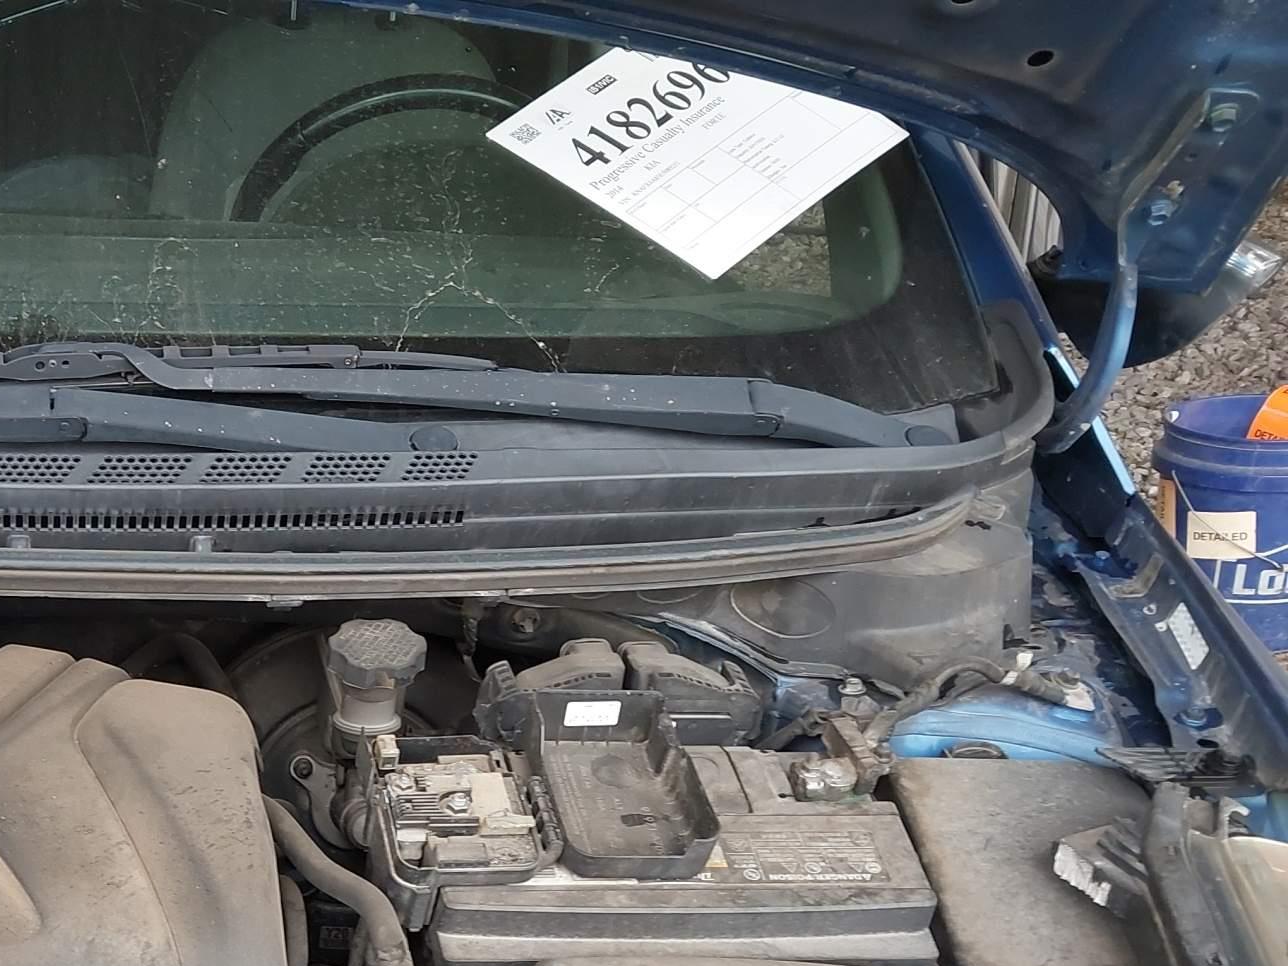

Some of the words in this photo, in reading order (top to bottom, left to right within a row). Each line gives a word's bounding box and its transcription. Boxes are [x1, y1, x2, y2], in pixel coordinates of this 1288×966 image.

[570, 60, 731, 167] 4182696
[589, 150, 646, 191] Progressive
[642, 124, 685, 154] Casualty
[680, 96, 725, 127] Insurance
